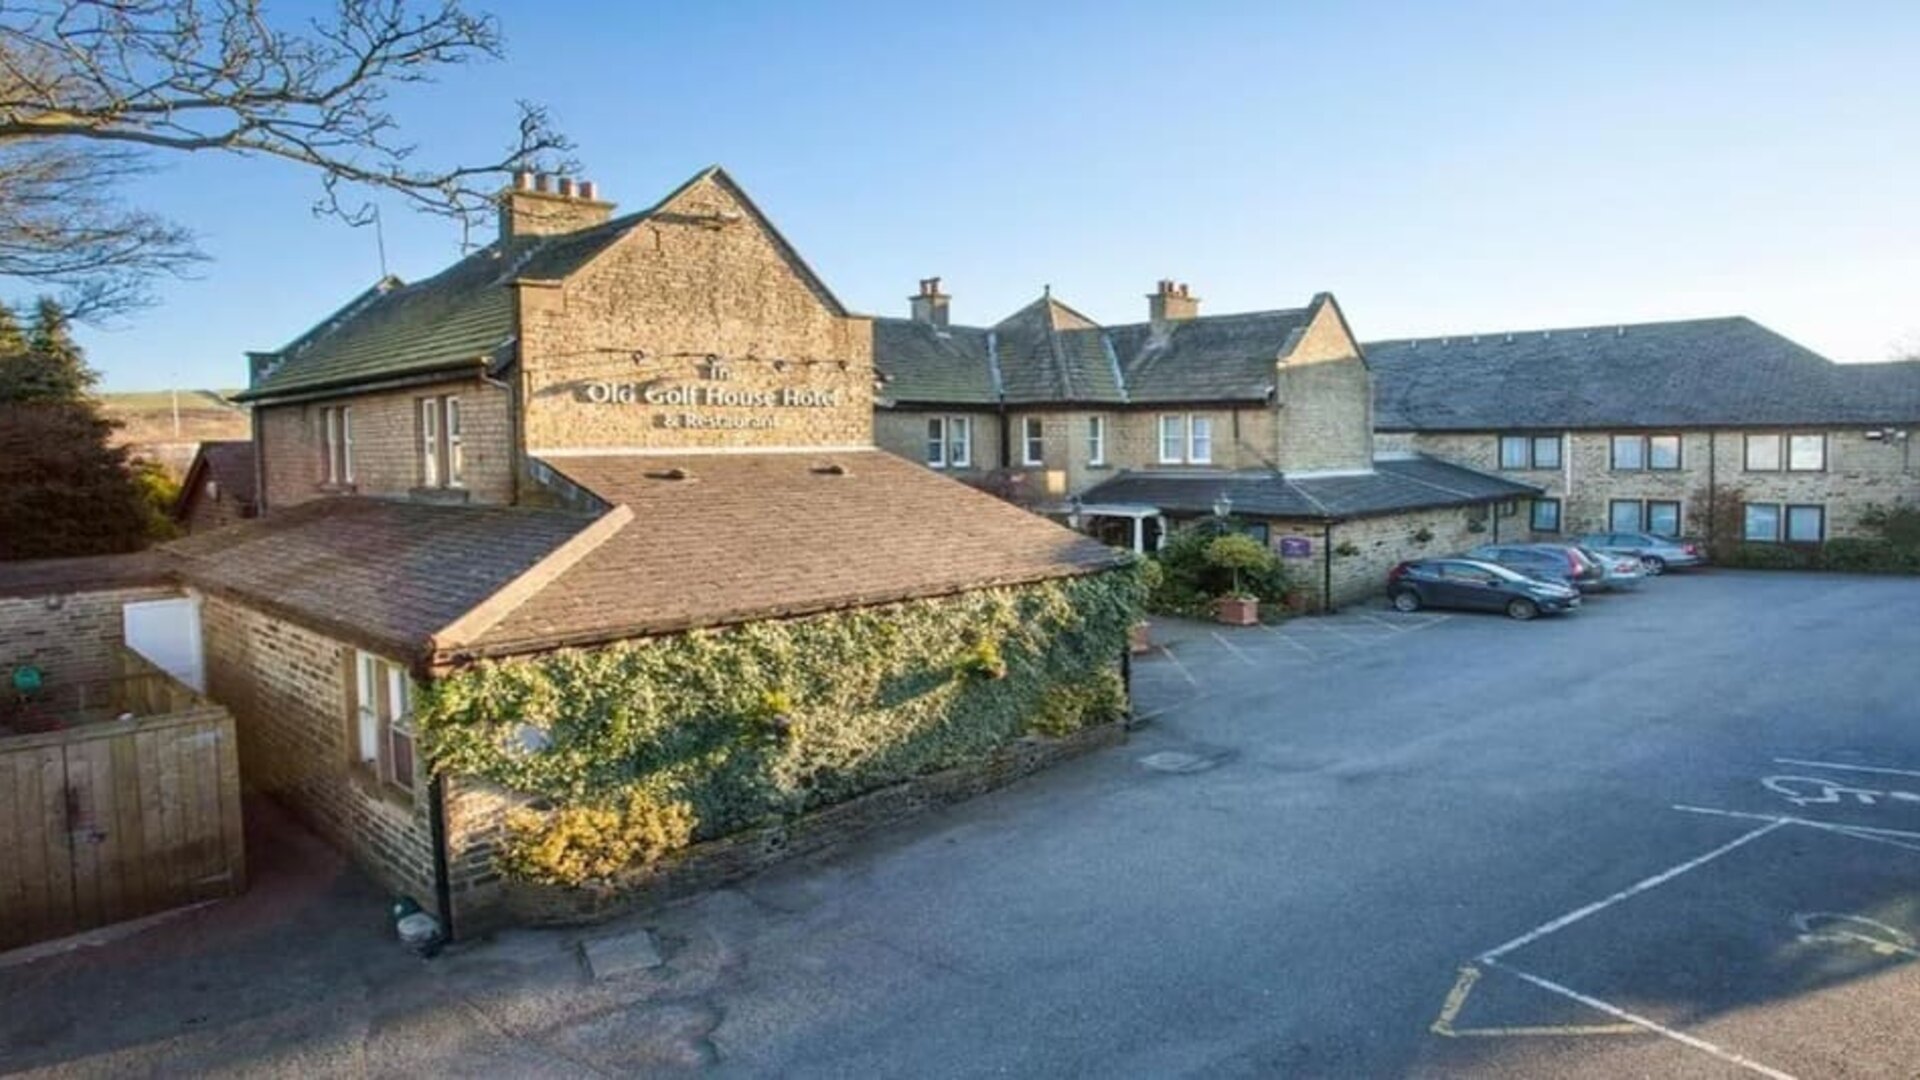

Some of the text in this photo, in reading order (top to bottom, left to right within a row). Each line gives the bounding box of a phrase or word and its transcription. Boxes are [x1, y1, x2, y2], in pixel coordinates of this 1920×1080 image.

[587, 381, 841, 407] Old Golf House Hotel
